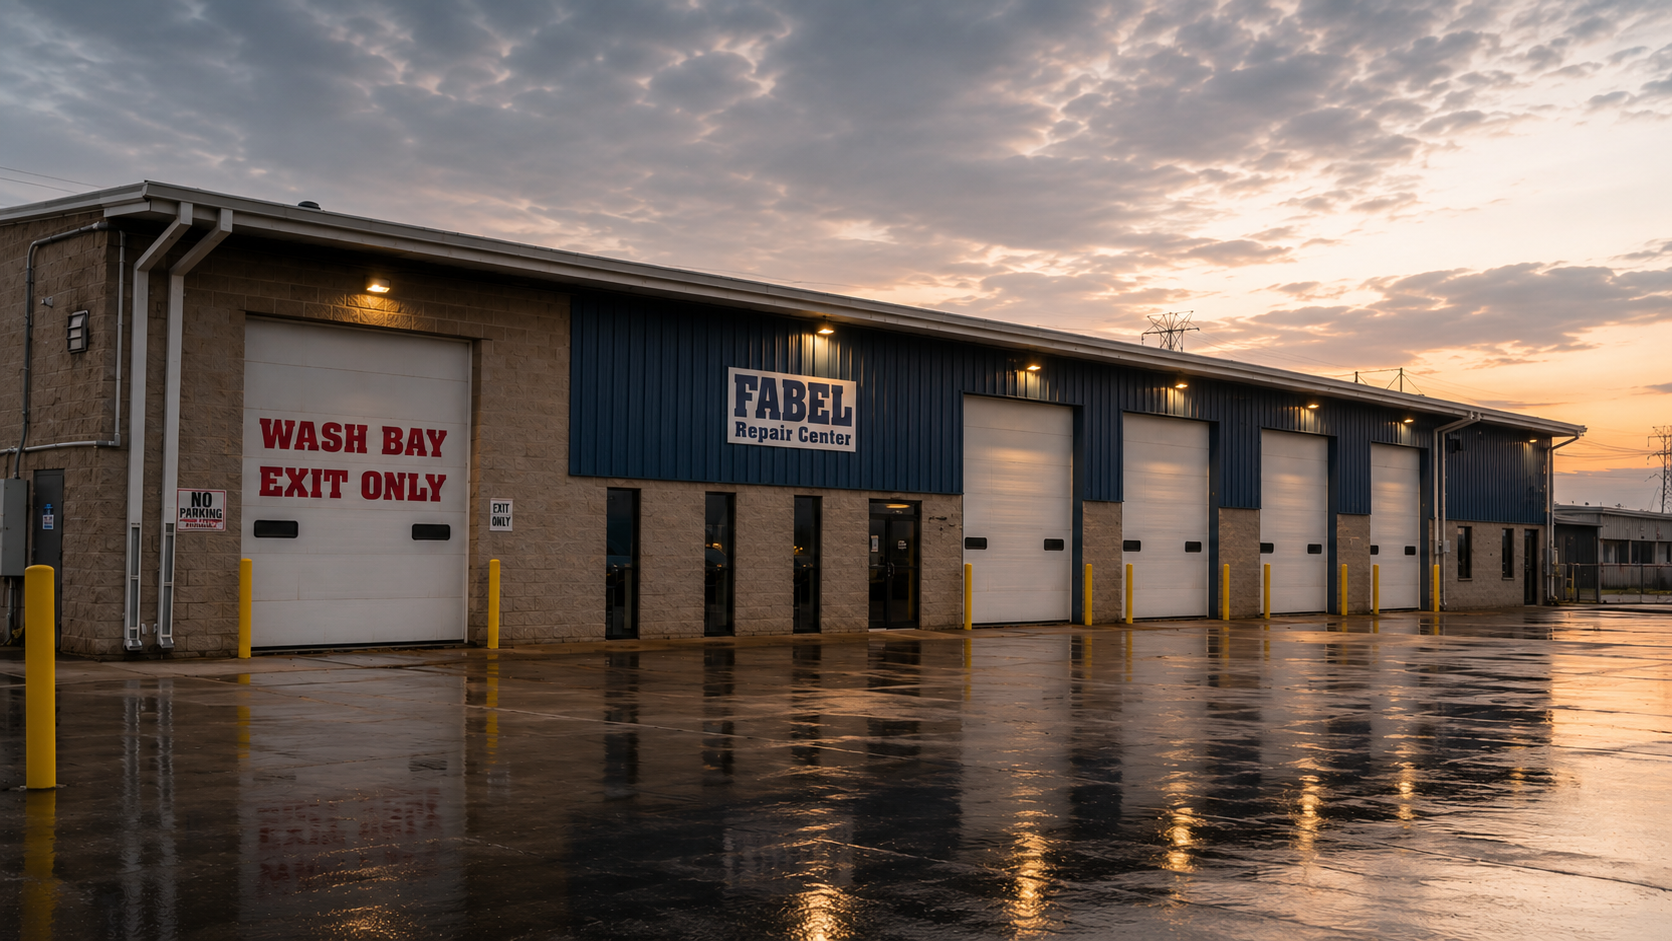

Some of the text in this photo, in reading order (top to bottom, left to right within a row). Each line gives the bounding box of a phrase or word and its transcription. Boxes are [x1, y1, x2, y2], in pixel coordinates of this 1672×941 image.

[734, 373, 852, 427] FABEL
[259, 418, 447, 457] WASH BAY
[735, 421, 851, 446] Repair Center
[259, 466, 446, 502] EXIT ONLY
[191, 491, 212, 508] NO
[493, 503, 510, 513] EXIT
[180, 508, 222, 518] PARKING
[492, 516, 511, 526] ONLY
